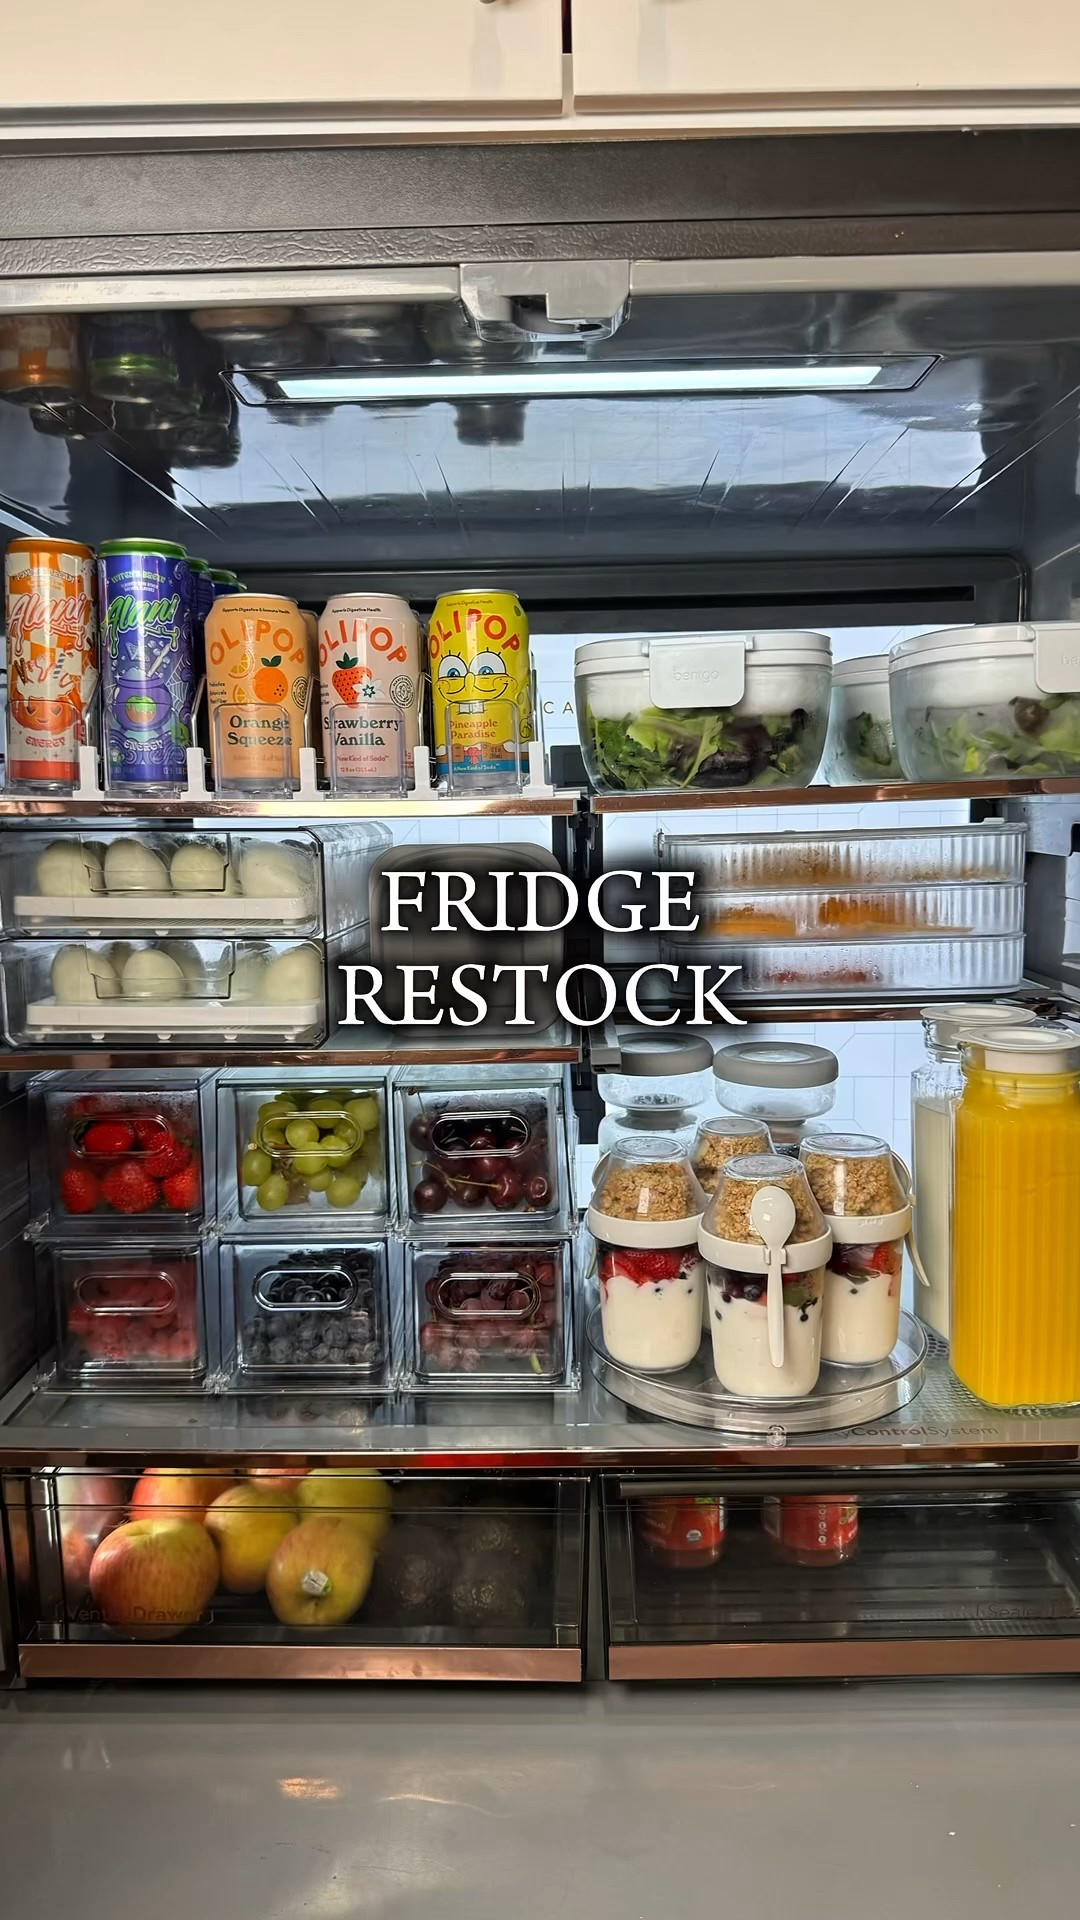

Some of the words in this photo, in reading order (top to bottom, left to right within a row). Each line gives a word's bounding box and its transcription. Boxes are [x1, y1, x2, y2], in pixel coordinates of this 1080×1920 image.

[7, 593, 86, 650] Alani
[106, 594, 180, 653] Alani
[429, 608, 520, 659] OLIPOP
[209, 619, 305, 666] OLIPOP
[319, 619, 407, 667] OLIPOP
[229, 714, 290, 731] Orange
[449, 718, 499, 730] Pineapple
[25, 735, 66, 748] ENERGY
[227, 731, 293, 748] Squeeze
[333, 732, 386, 746] Vanilla
[450, 730, 497, 740] Paradise
[124, 739, 164, 752] ENERGY
